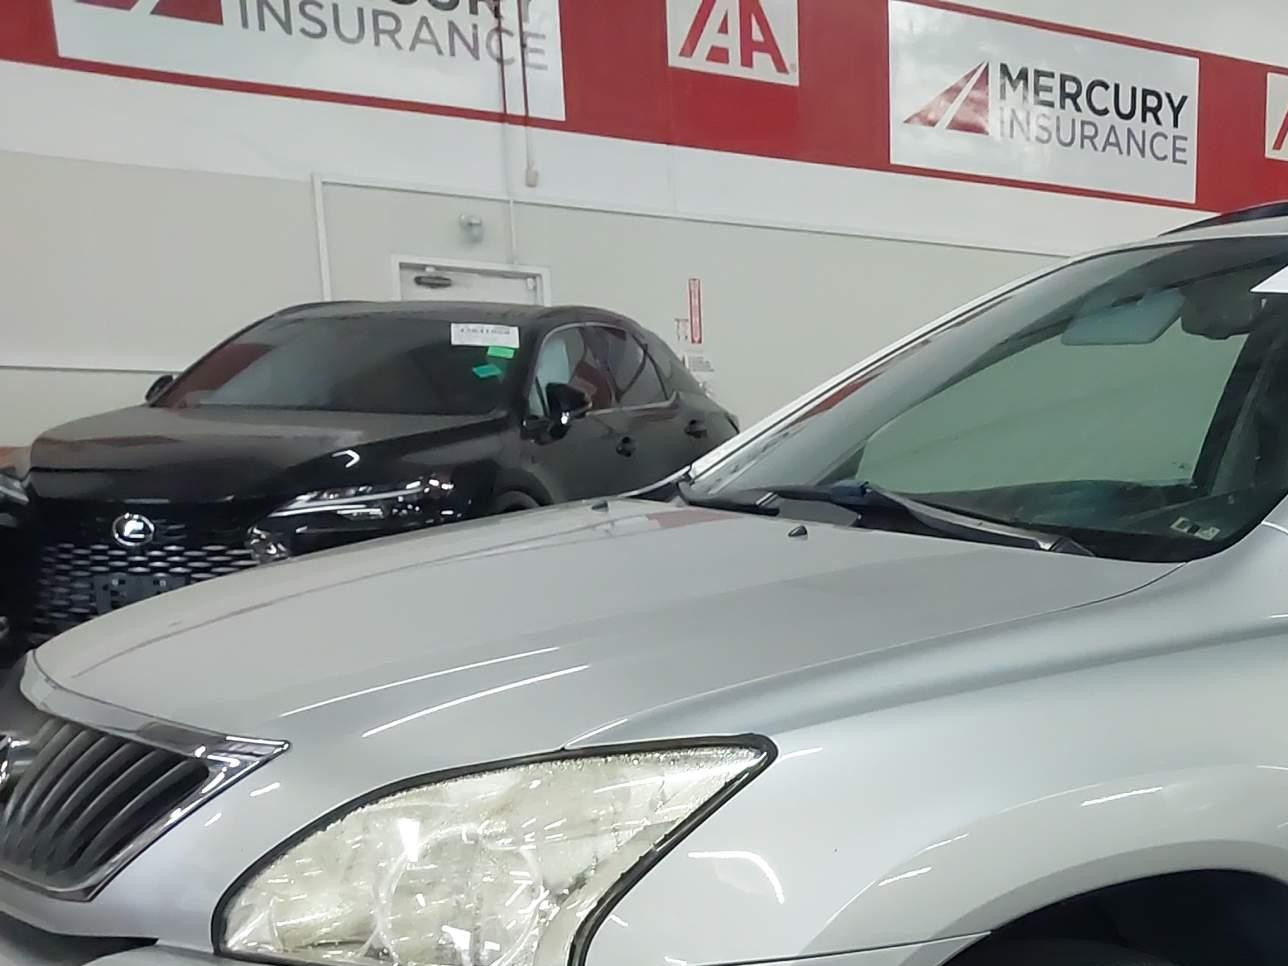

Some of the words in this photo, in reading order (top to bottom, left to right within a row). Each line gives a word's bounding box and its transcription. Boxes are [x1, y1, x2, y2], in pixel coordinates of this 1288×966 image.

[239, 0, 549, 71] INSURANCE
[1000, 62, 1189, 128] MERCURY
[1000, 106, 1189, 165] INSURANCE
